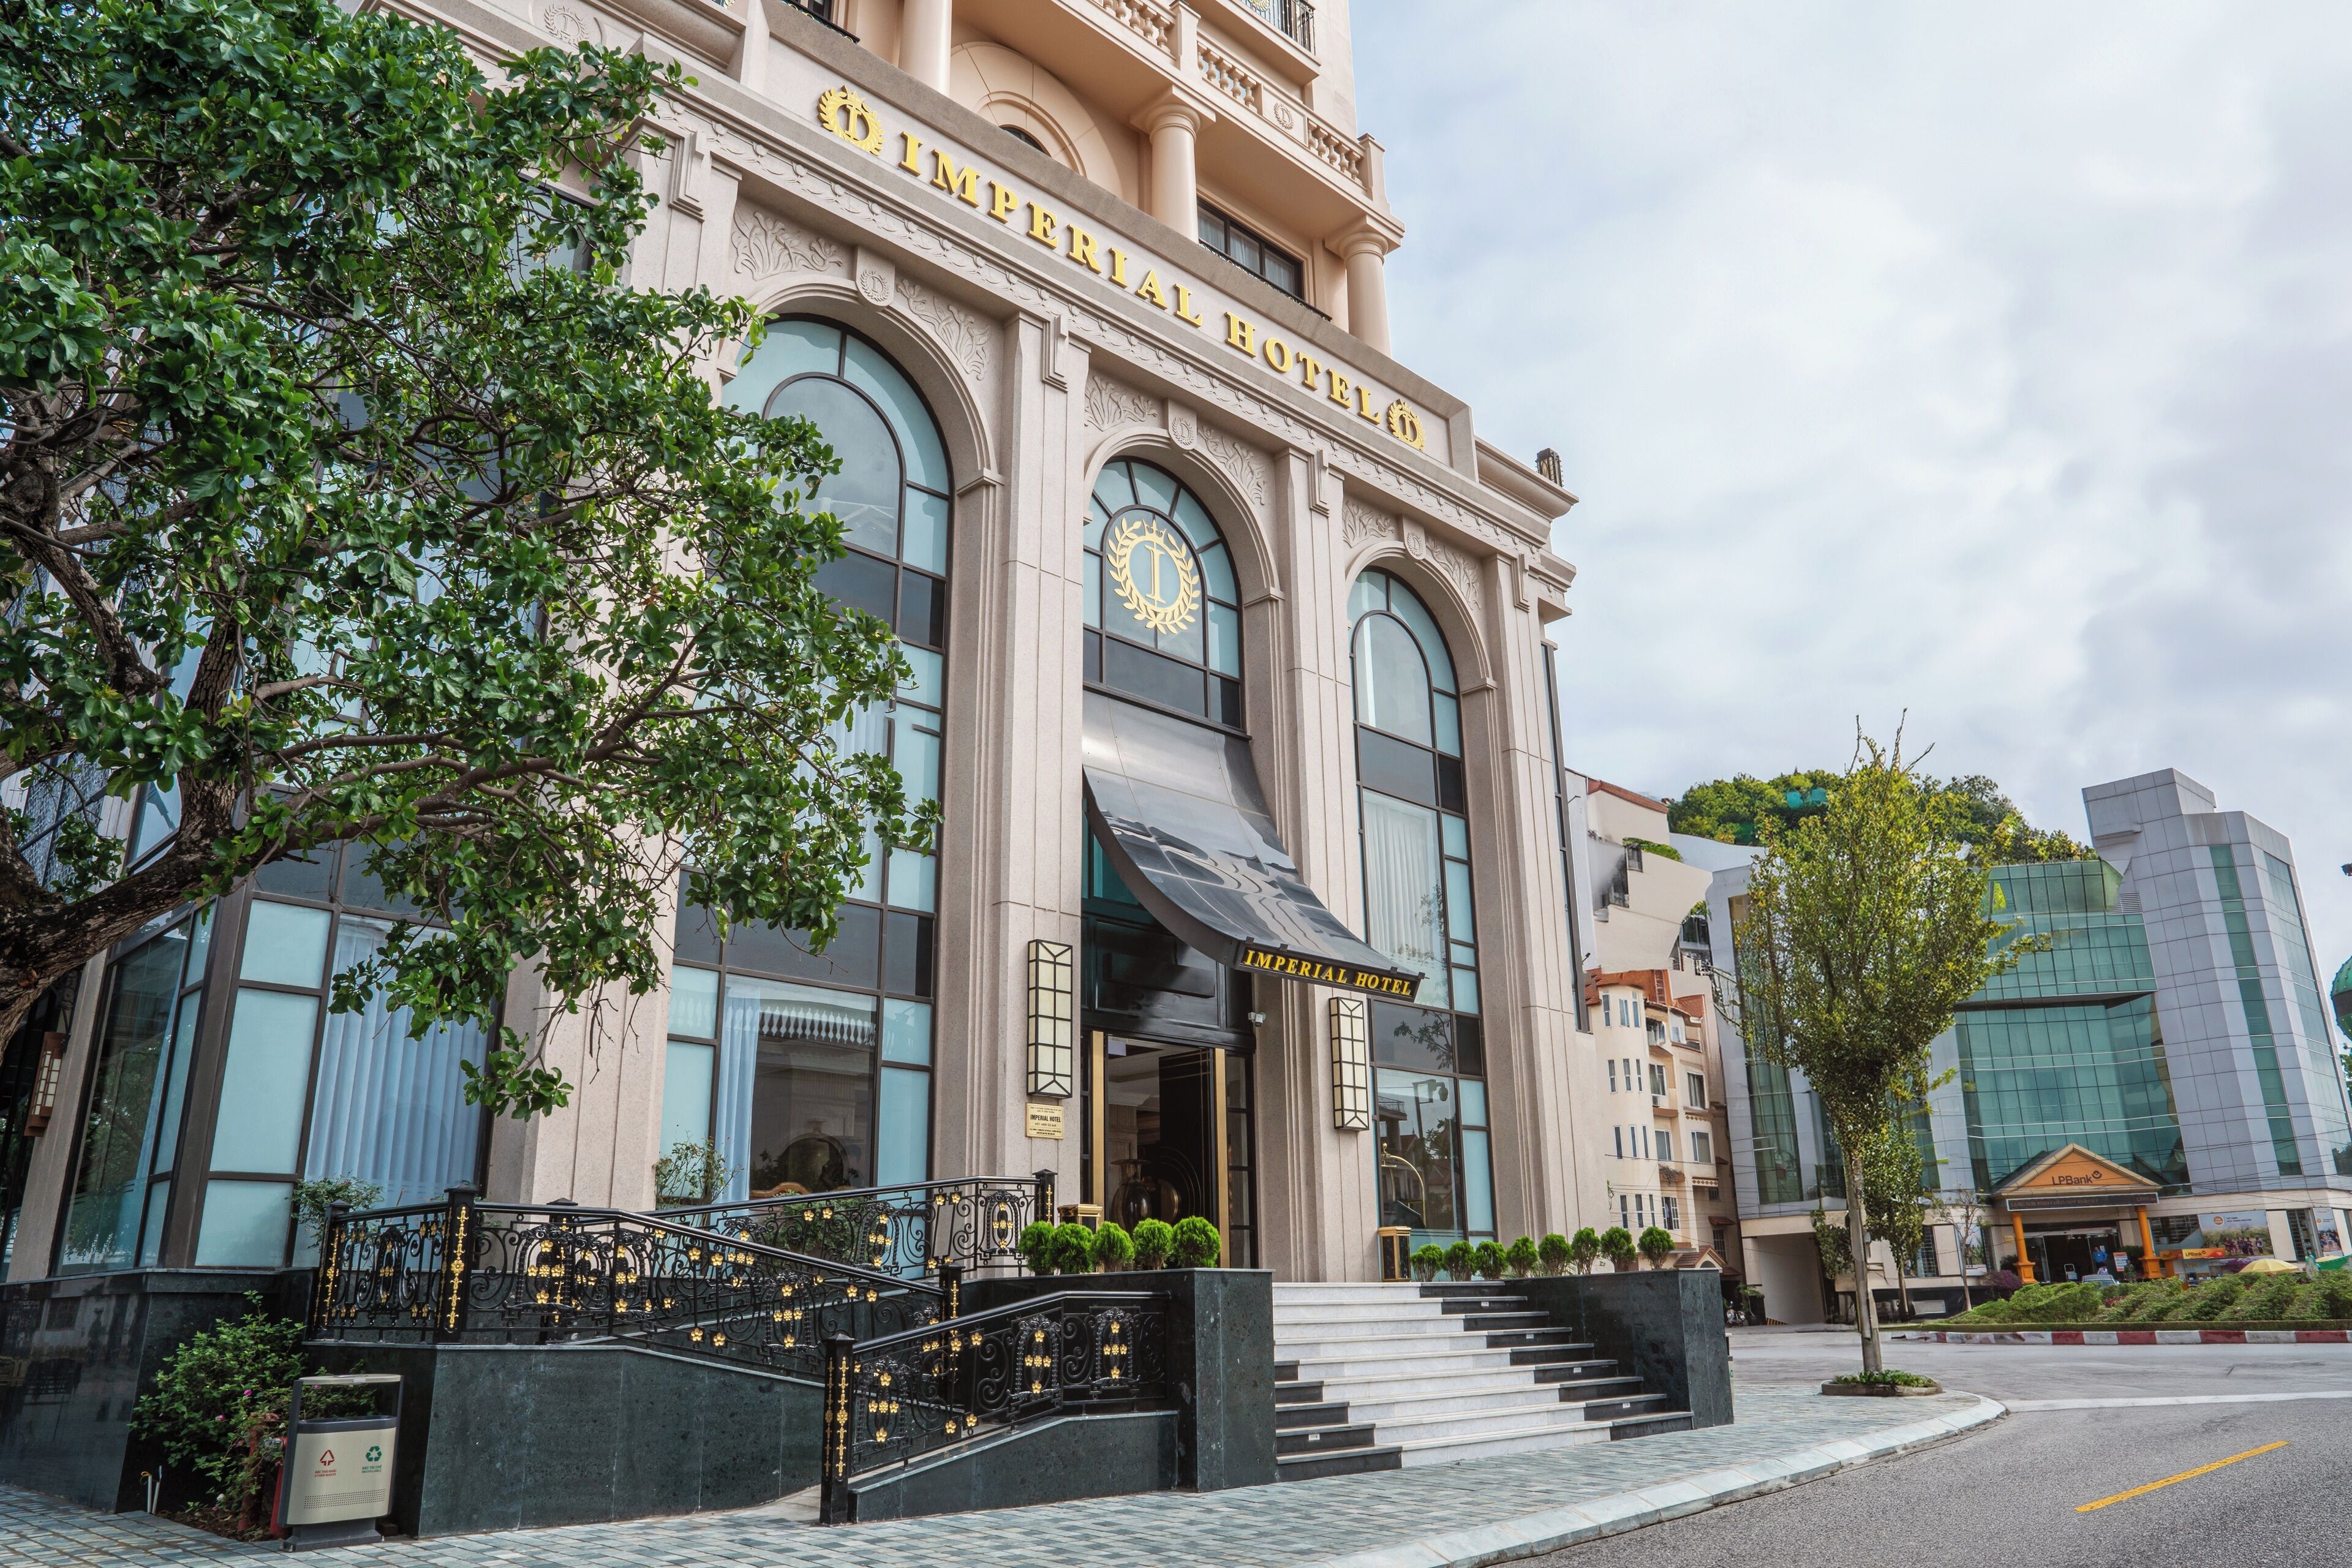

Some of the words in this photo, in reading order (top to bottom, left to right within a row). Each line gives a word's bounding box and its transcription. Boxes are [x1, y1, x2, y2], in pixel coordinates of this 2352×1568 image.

[899, 130, 1202, 327] IMPERIAL
[1225, 311, 1382, 425] HOTEL
[1244, 949, 1348, 984] IMPERIAL
[1354, 971, 1412, 996] HOTEL
[2052, 1175, 2093, 1185] LPBank
